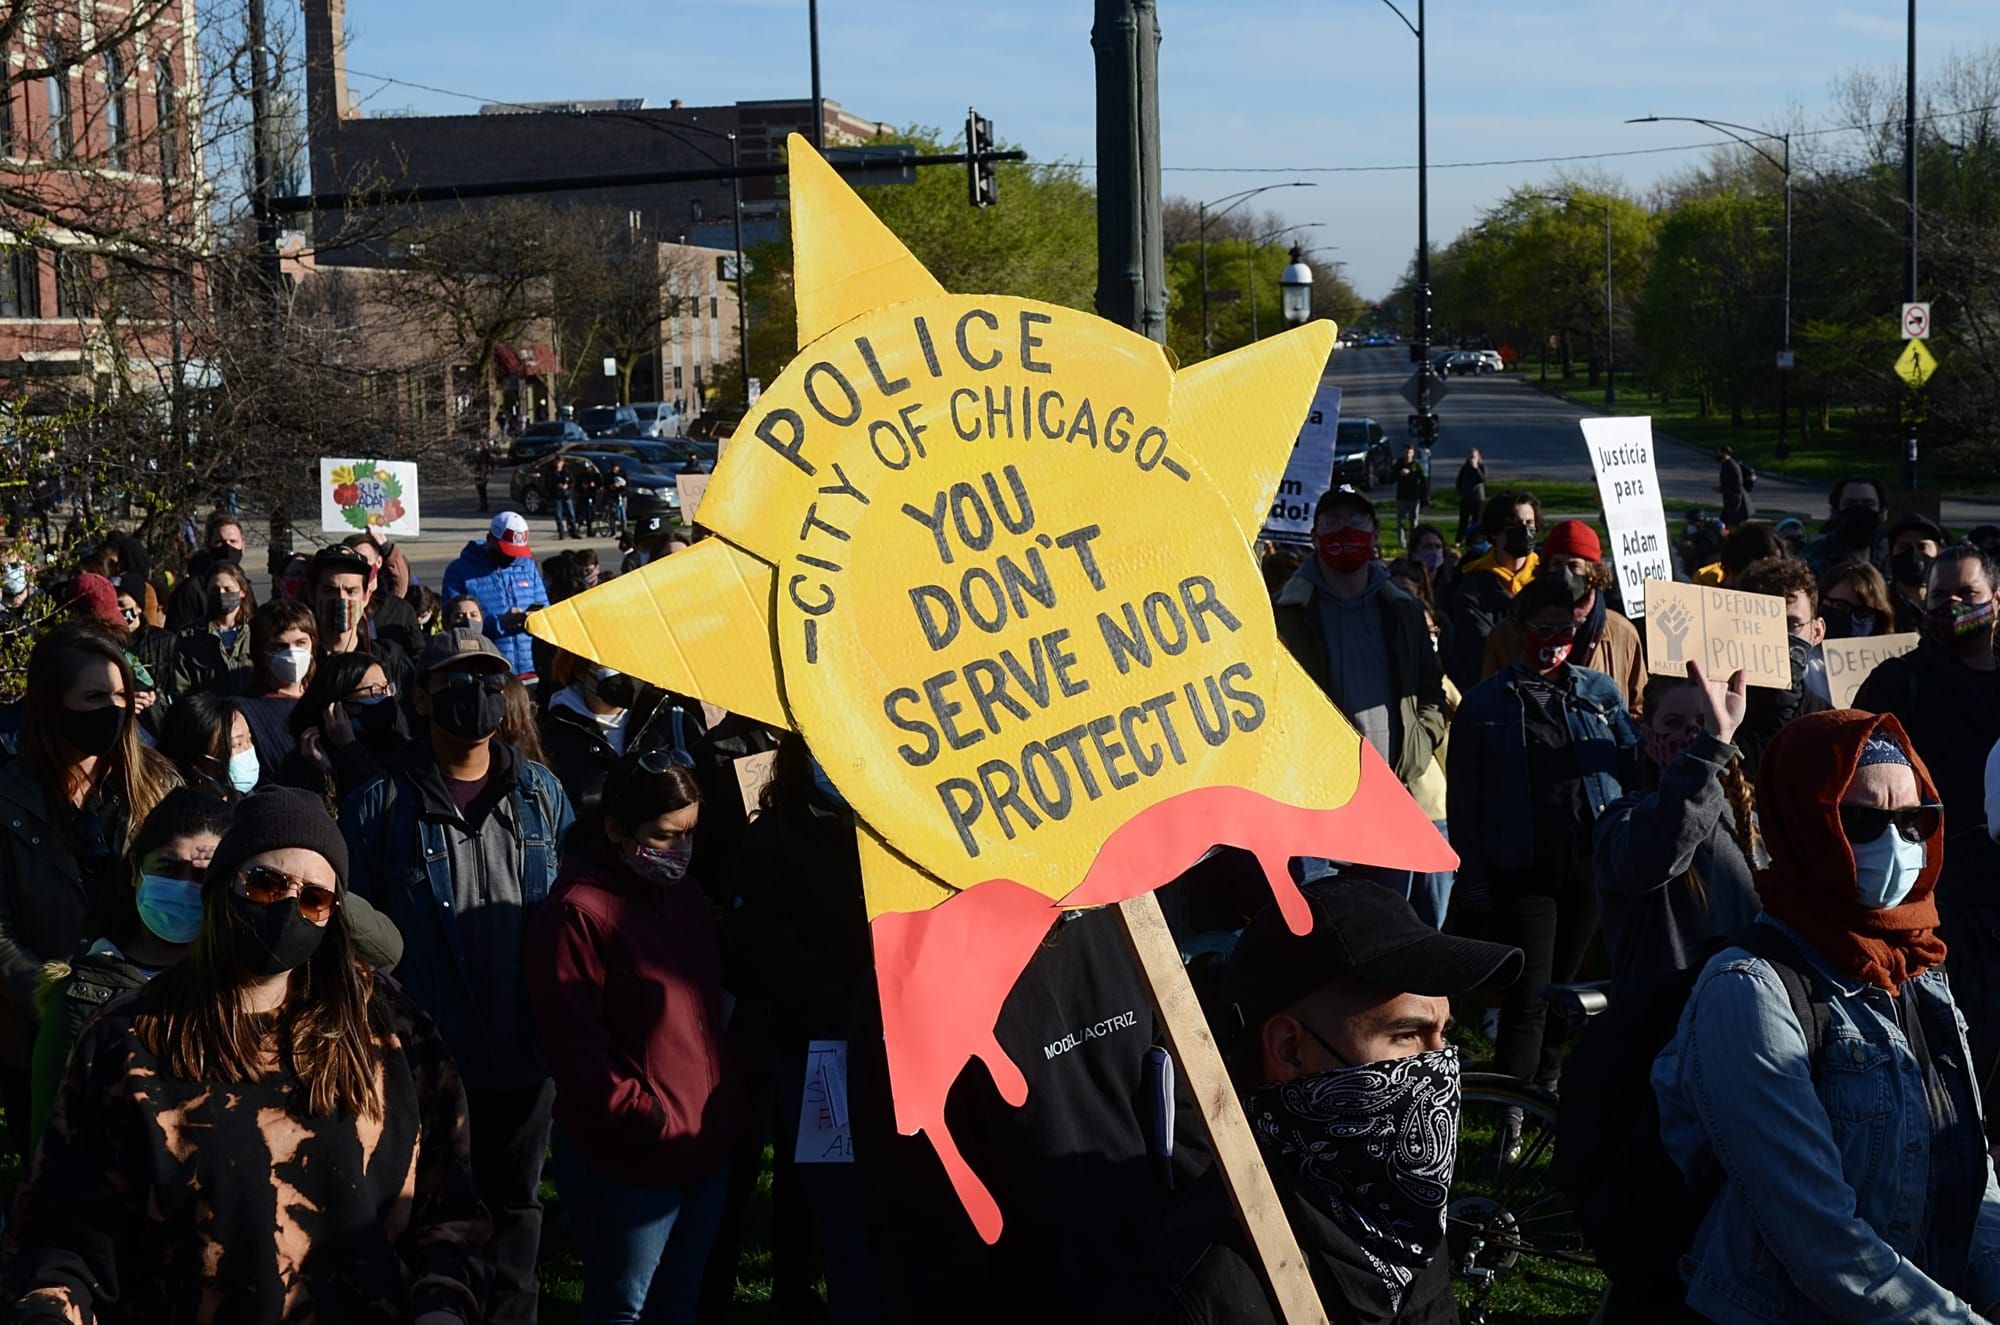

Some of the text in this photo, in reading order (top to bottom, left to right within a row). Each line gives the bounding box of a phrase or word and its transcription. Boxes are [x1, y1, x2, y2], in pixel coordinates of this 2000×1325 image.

[755, 309, 1052, 476] POLICE
[869, 403, 929, 470] OF
[902, 465, 1035, 564] YOU
[1614, 479, 1644, 504] para
[1622, 530, 1658, 556] Adam
[909, 524, 1106, 651] DON'T
[1622, 559, 1667, 588] Toledo!
[1711, 591, 1781, 619] DEFUND
[1732, 618, 1762, 635] THE
[884, 574, 1242, 766] SERVE NOR
[1711, 636, 1787, 680] POLICE
[937, 662, 1268, 857] PROTECT US
